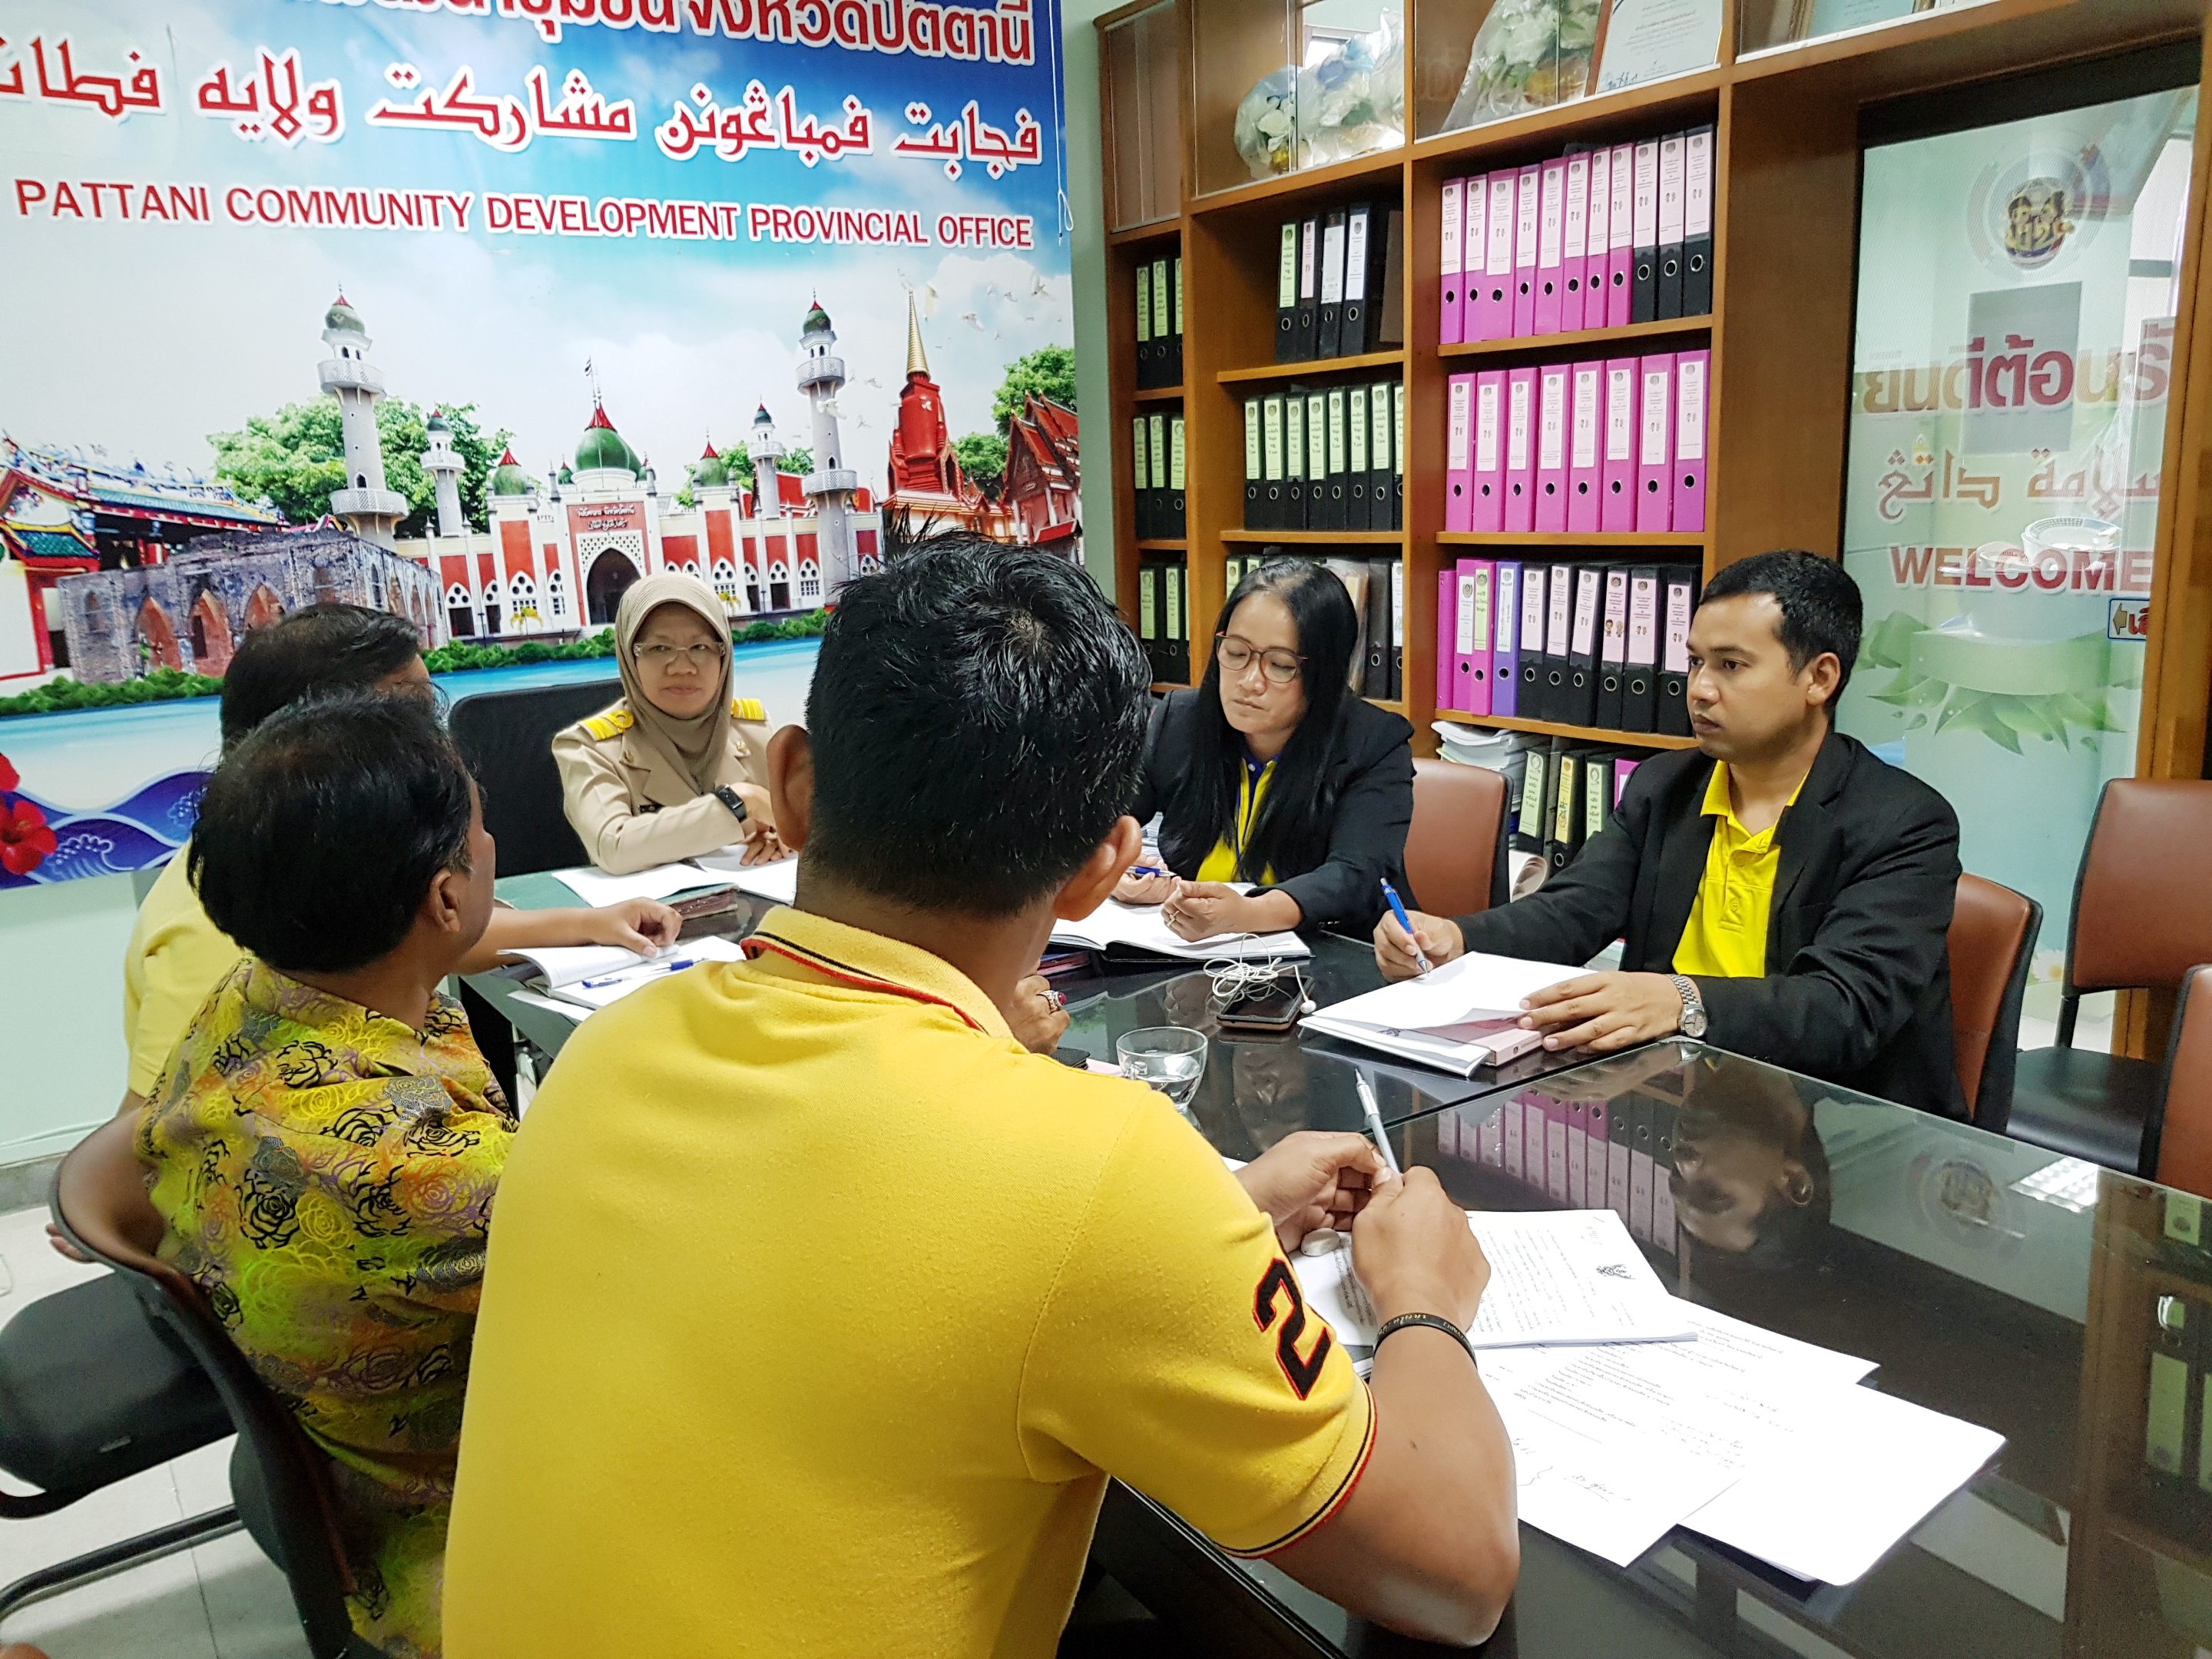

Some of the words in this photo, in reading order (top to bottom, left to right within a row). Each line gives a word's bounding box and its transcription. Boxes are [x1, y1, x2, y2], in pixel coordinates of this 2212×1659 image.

[15, 180, 209, 220] PATTANI
[227, 188, 470, 227] COMMUNITY
[488, 197, 738, 236] DEVELOPMENT
[751, 208, 928, 243] PROVINCIAL
[939, 216, 1031, 246] OFFICE
[1890, 547, 2153, 591] WELCOME
[1253, 1257, 1333, 1401] 2
